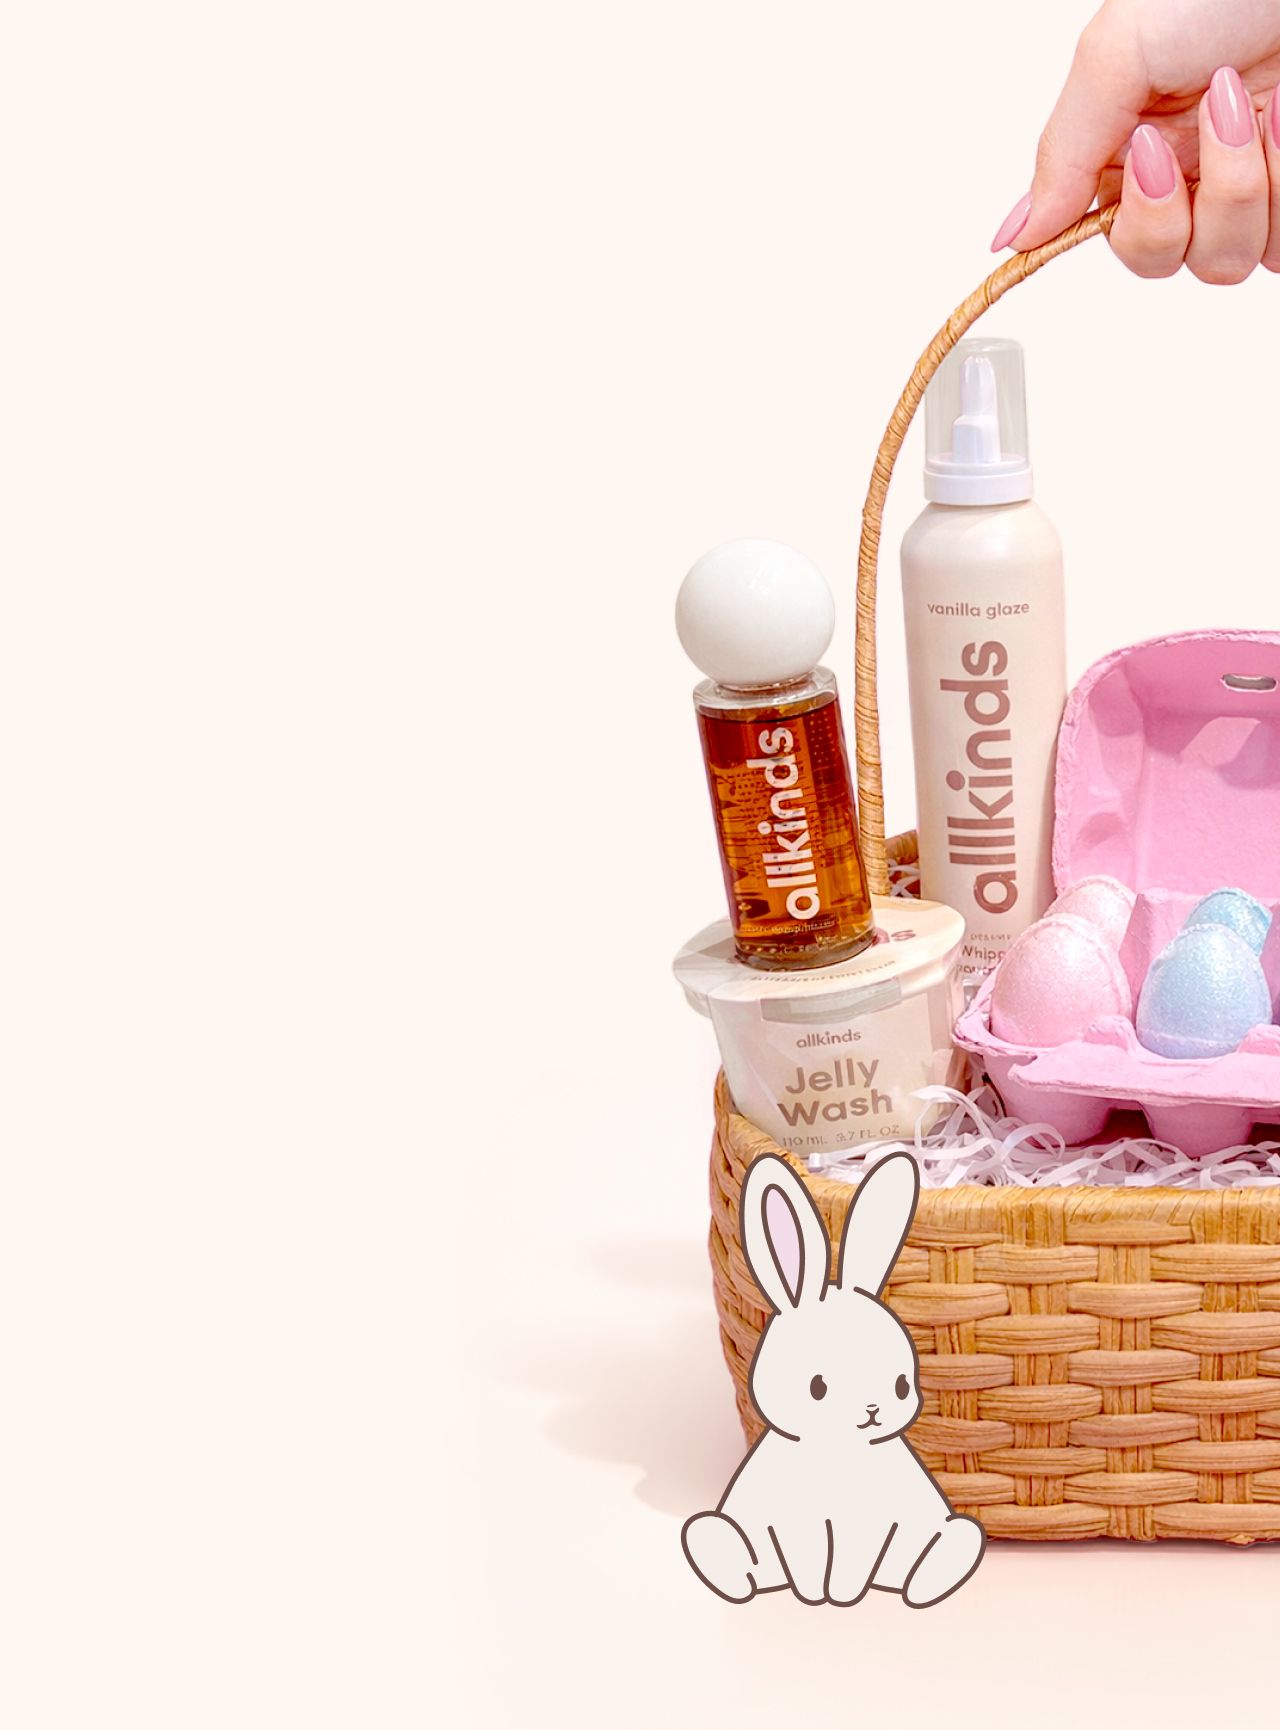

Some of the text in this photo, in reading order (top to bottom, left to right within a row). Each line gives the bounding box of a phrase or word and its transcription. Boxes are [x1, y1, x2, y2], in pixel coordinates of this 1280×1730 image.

[927, 602, 1030, 620] vanilla glaze
[940, 640, 1018, 914] allkinds
[746, 726, 821, 920] allkinds
[796, 1029, 862, 1048] allkinds
[785, 1058, 879, 1094] Jelly
[777, 1089, 893, 1127] Wash
